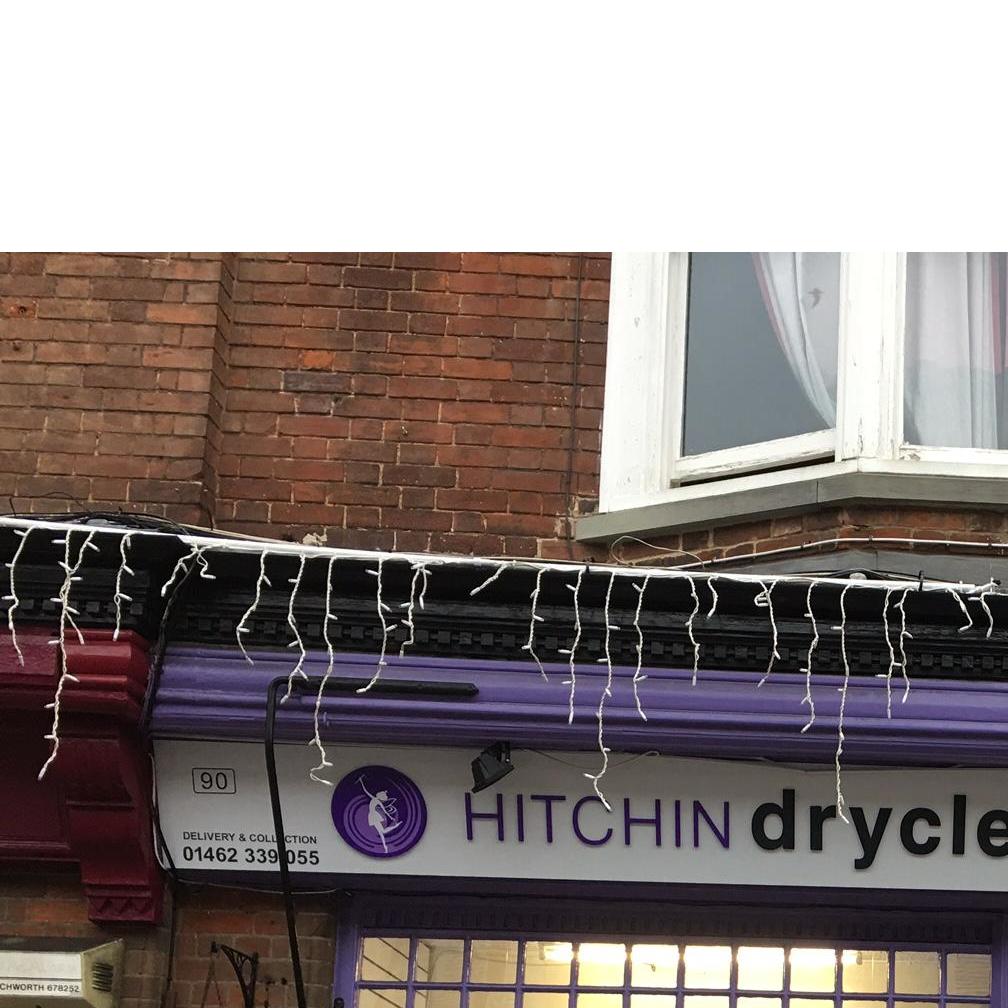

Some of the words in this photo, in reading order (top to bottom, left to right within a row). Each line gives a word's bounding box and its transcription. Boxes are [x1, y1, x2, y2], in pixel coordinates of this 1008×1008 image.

[200, 771, 228, 790] 90
[464, 791, 732, 849] HITCHIN
[182, 831, 236, 842] DELIVERY
[238, 833, 247, 842] &
[249, 833, 318, 845] COLLCTION
[182, 846, 238, 863] 01462
[244, 848, 278, 864] 339
[286, 849, 320, 866] 055
[46, 984, 80, 993] 678252
